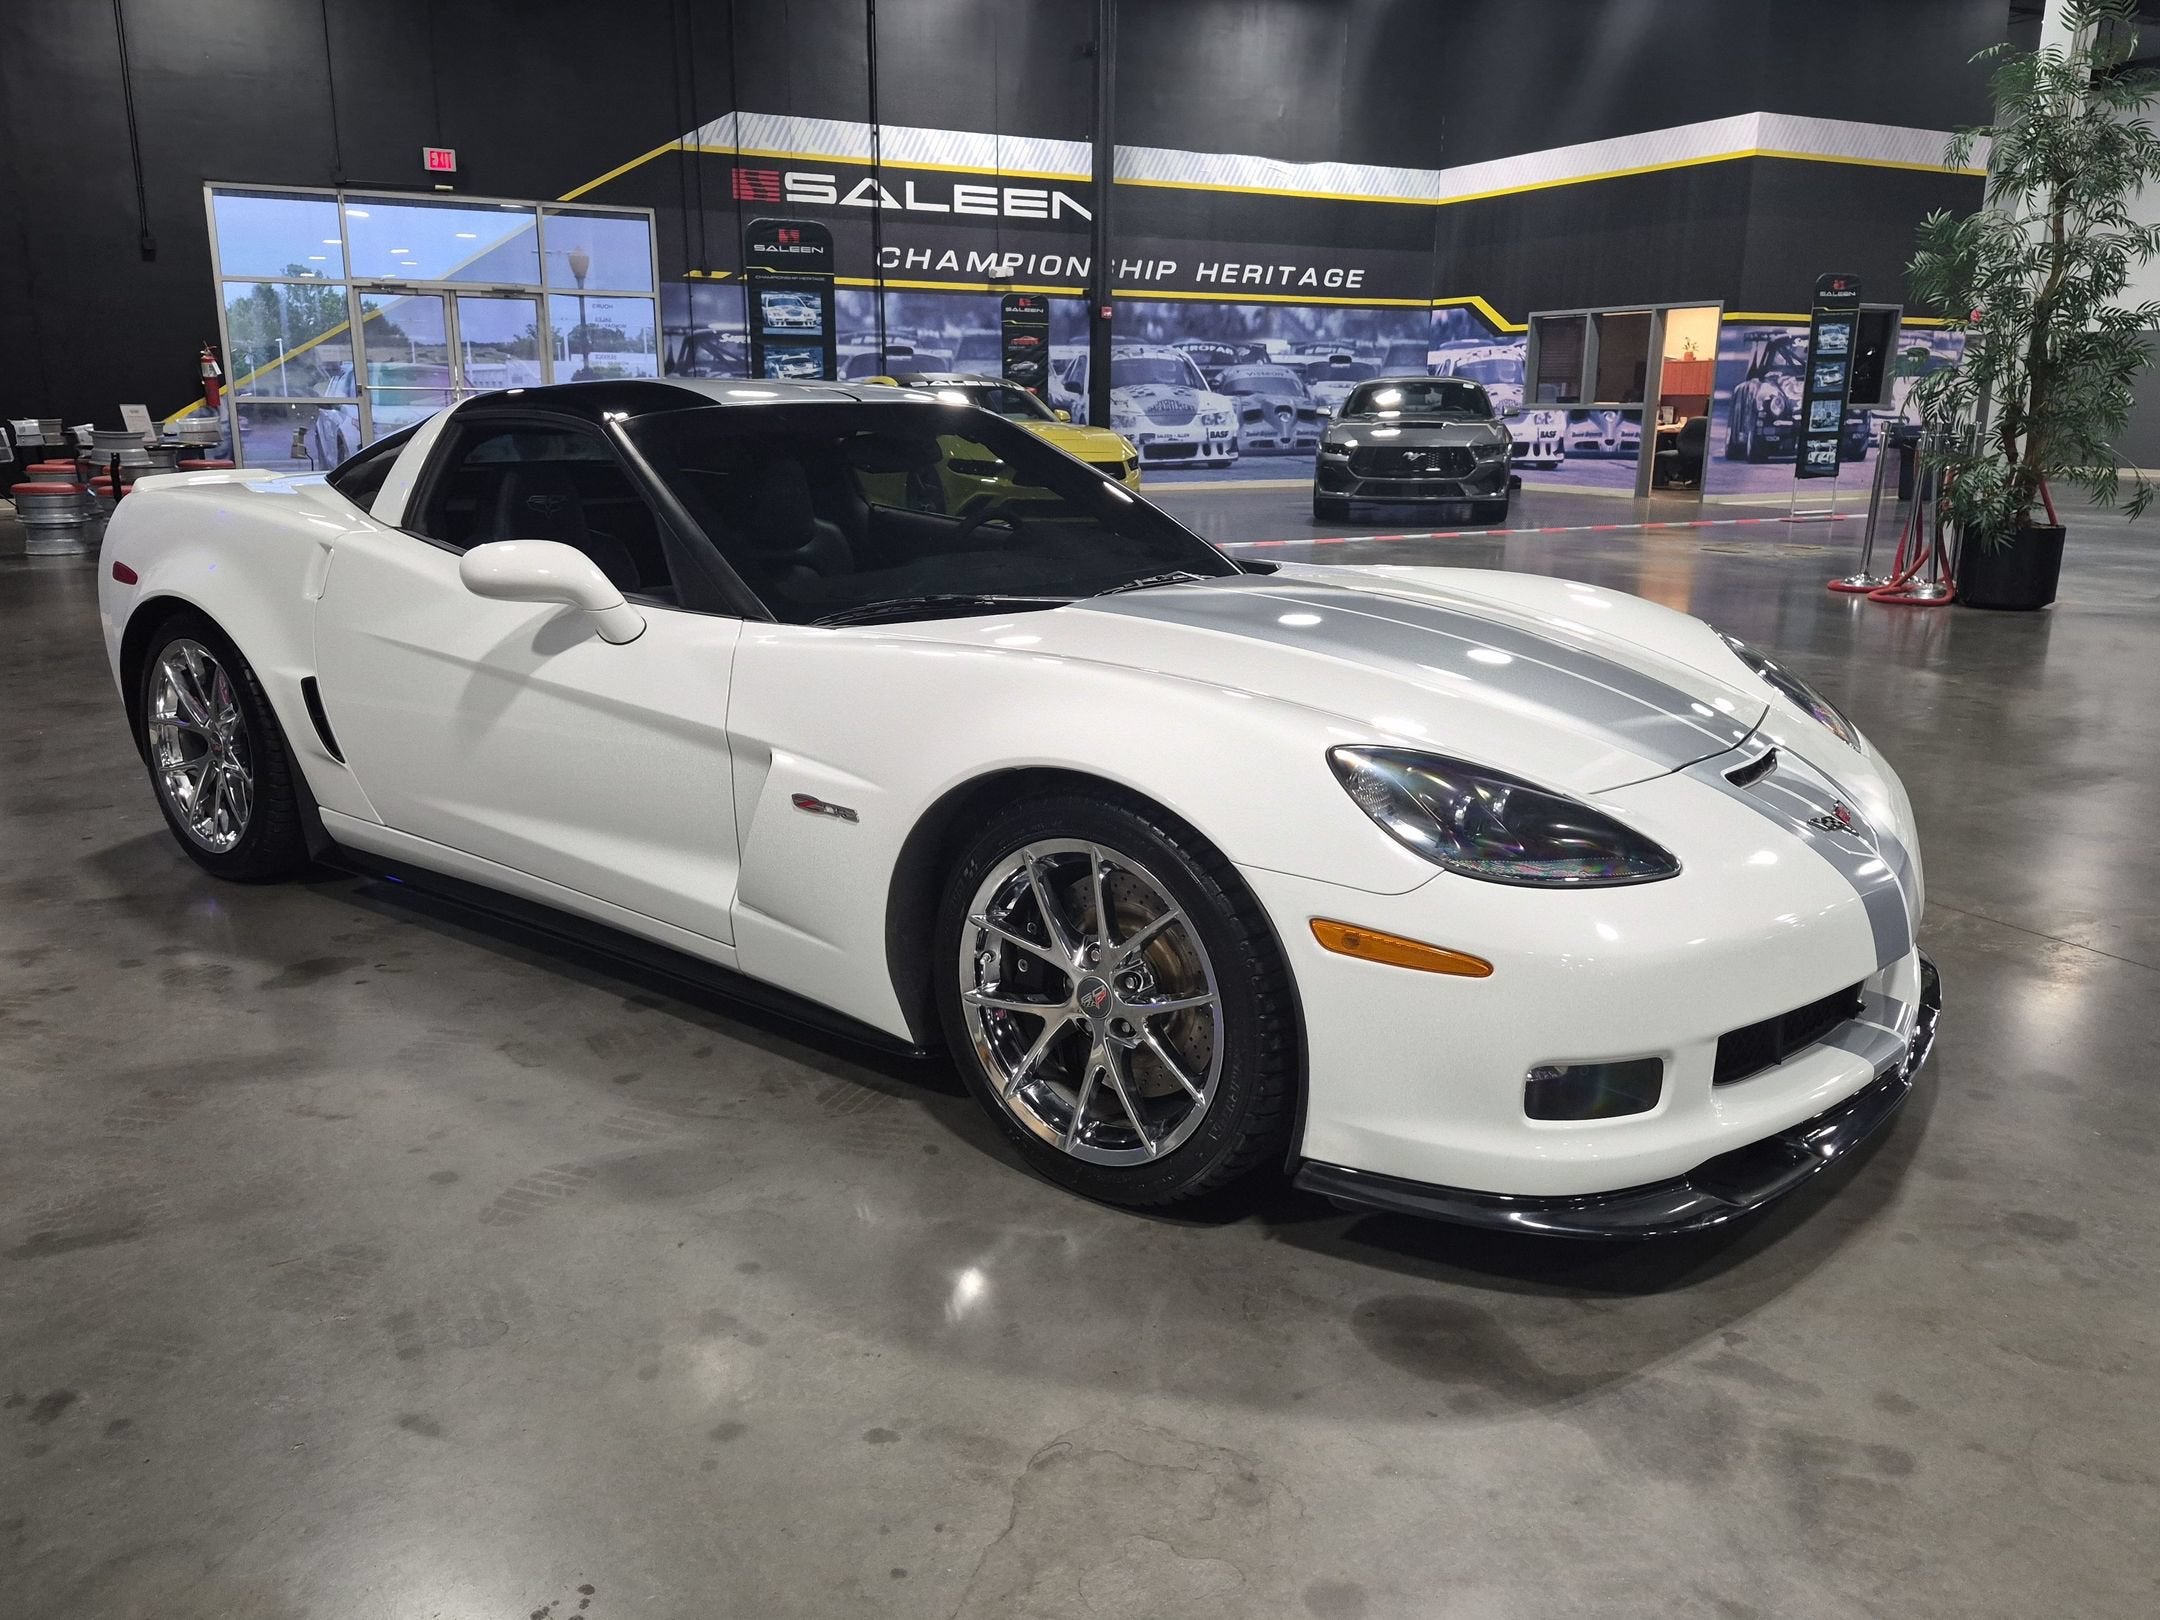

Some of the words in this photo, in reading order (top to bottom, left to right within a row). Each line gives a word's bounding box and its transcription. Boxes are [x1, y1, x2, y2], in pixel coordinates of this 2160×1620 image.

[429, 150, 453, 169] EXIT
[785, 171, 1092, 222] SALEEN
[753, 244, 824, 254] SALEEN
[1196, 262, 1365, 289] HERITAGE
[1210, 430, 1229, 439] BASF
